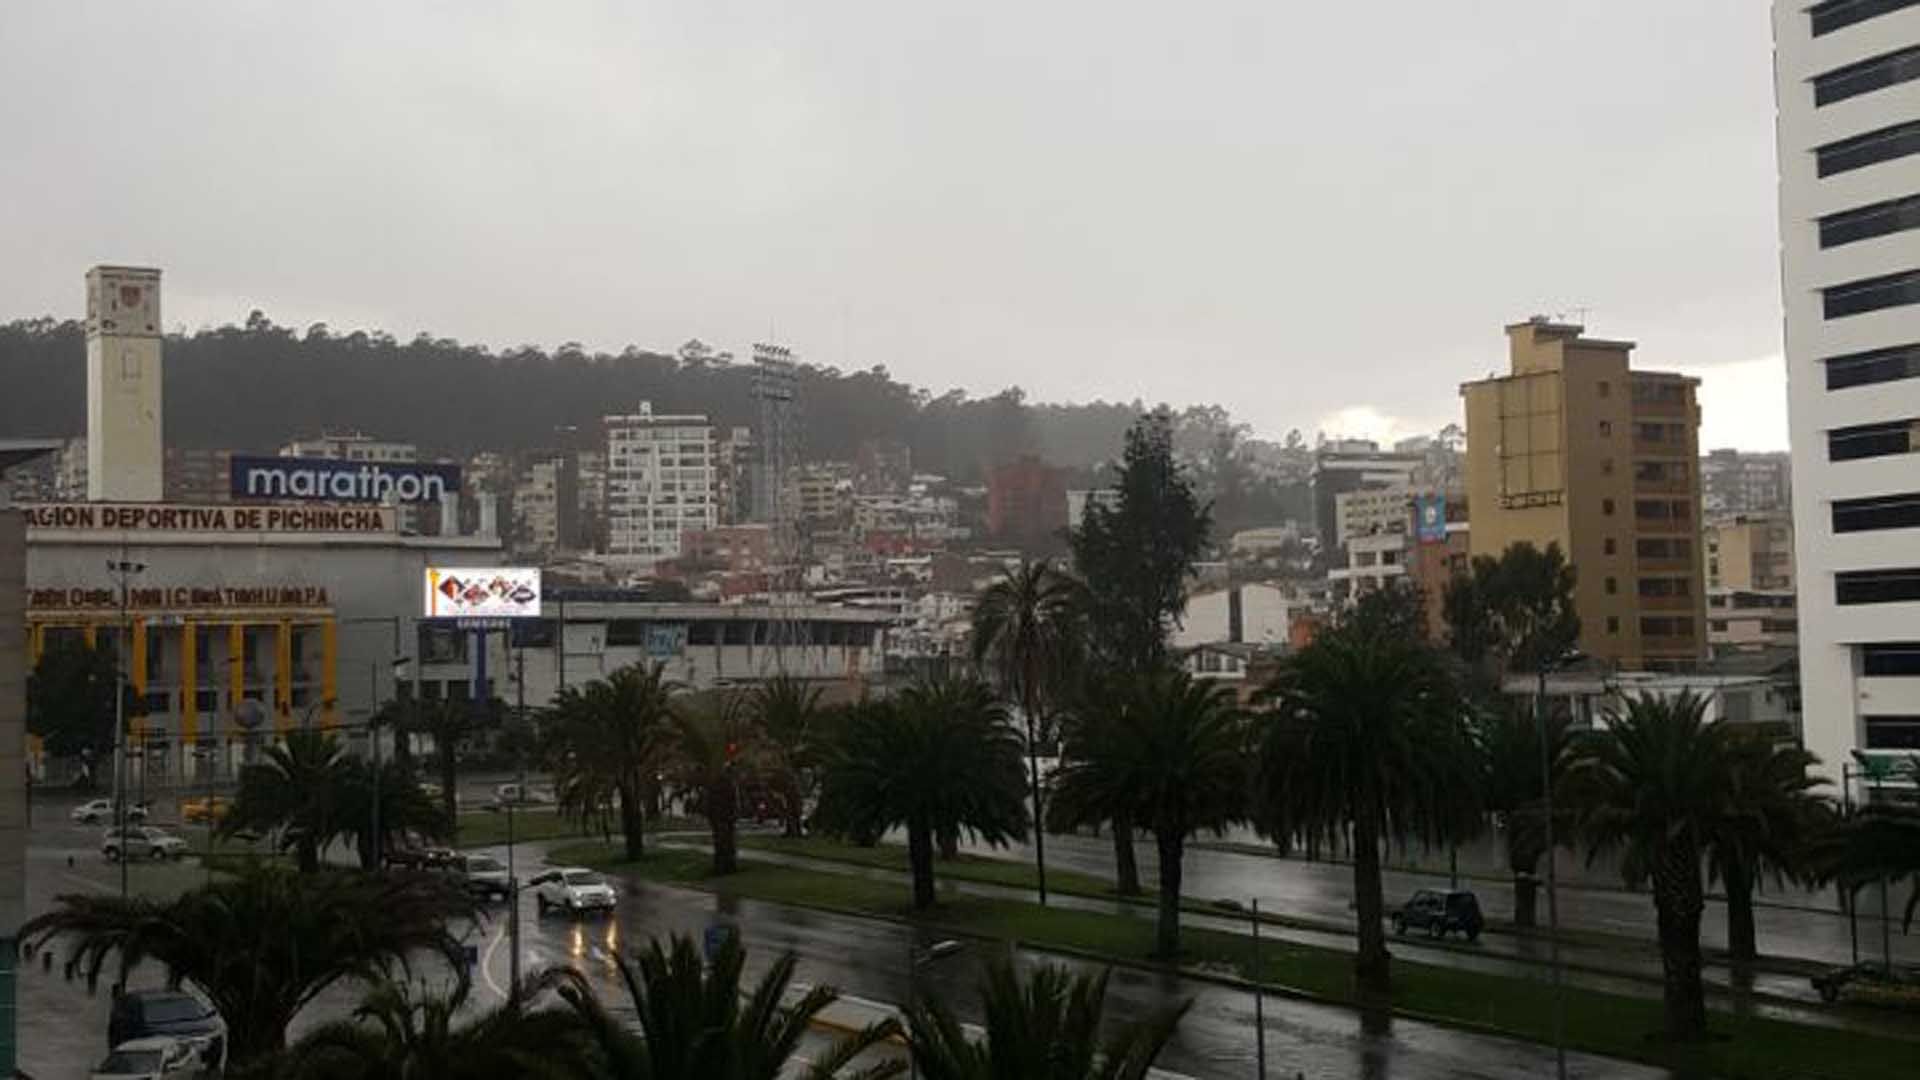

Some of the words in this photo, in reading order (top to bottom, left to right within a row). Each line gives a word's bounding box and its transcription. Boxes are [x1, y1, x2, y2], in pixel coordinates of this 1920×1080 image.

[249, 466, 445, 500] marathon
[103, 507, 227, 529] DEPORTIVA
[233, 508, 262, 529] DE
[268, 509, 385, 530] PICHINCHA
